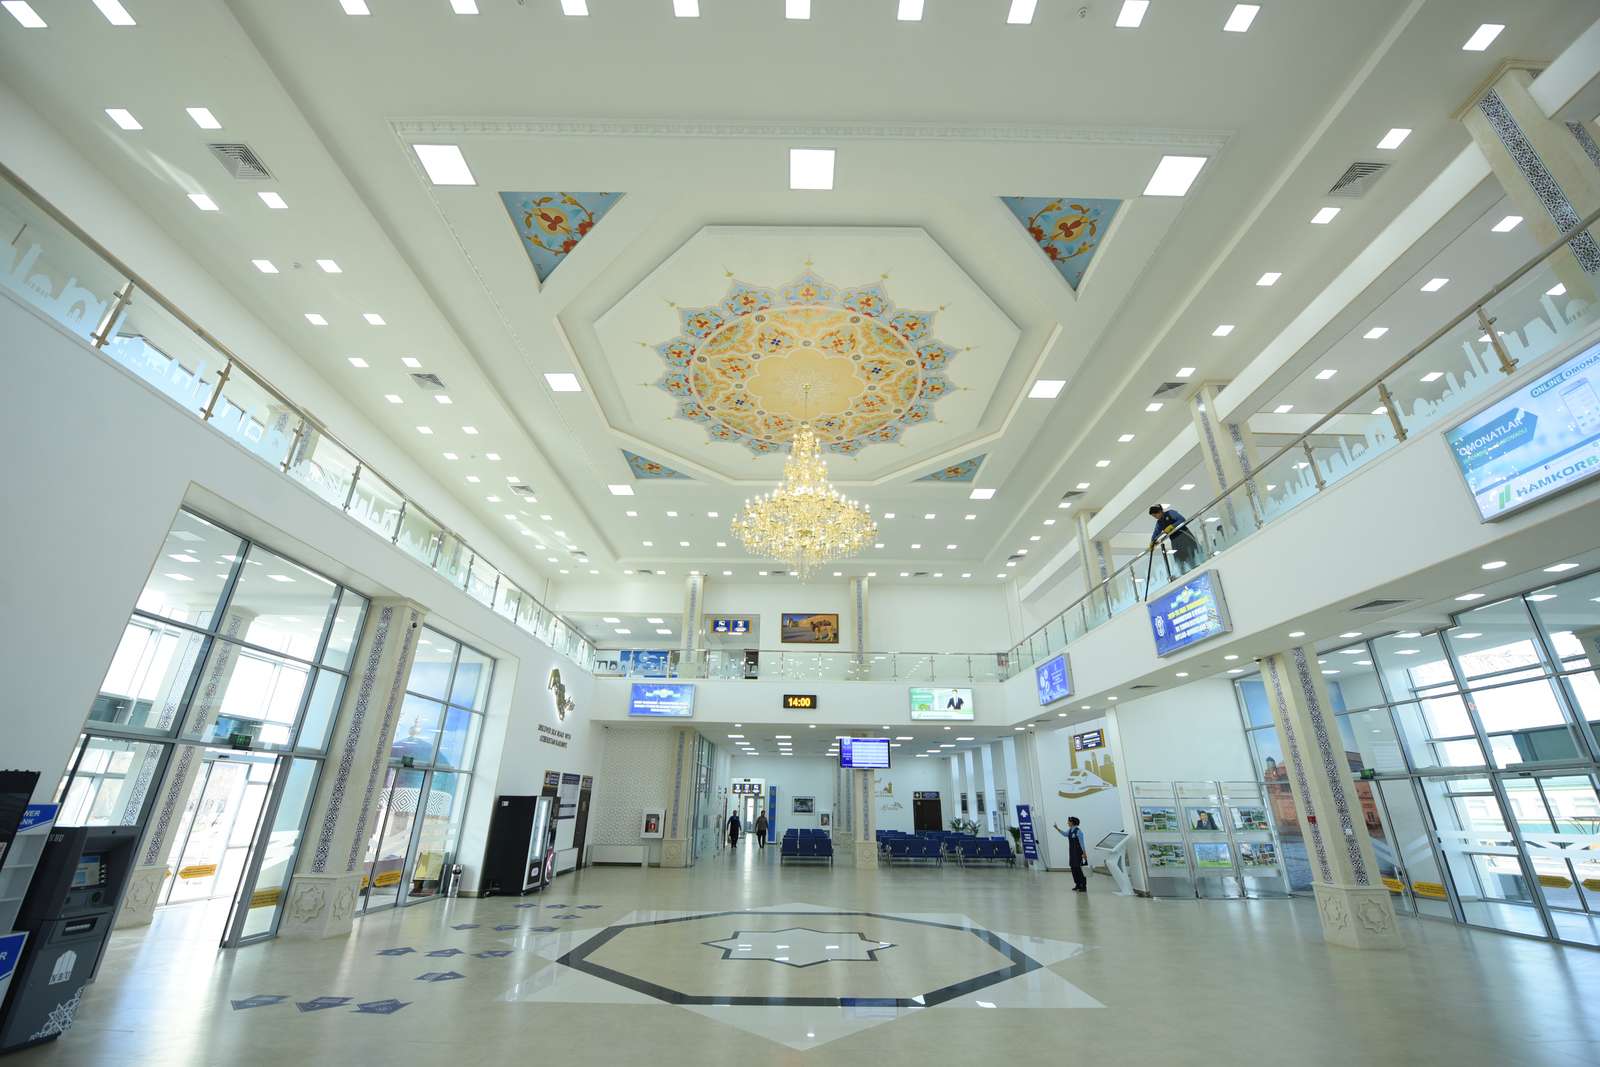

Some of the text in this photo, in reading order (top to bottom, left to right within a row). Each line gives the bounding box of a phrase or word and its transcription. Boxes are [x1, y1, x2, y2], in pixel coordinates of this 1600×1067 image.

[1532, 375, 1563, 396] ONLINE
[1458, 417, 1524, 456] OMONATLAR
[1516, 456, 1600, 497] HAMKORB
[788, 697, 811, 707] 14:00
